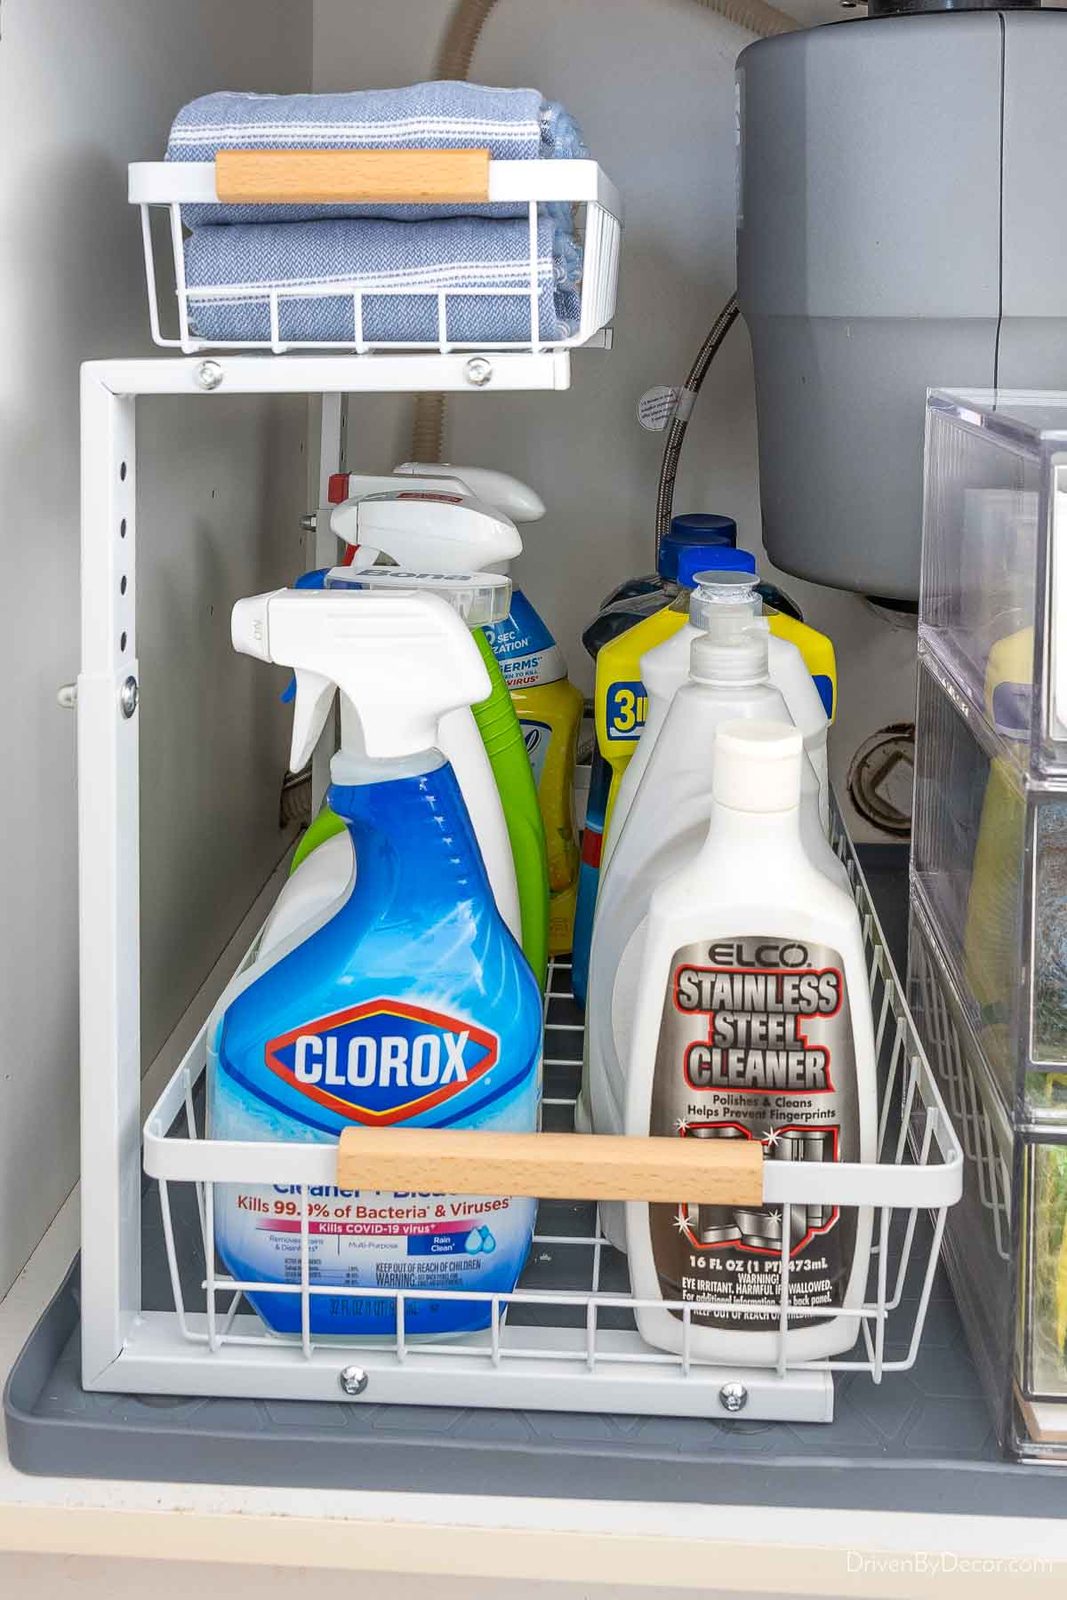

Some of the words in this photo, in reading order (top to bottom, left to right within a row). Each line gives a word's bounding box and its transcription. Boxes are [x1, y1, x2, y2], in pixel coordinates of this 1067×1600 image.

[356, 569, 472, 581] Bona
[497, 631, 516, 642] SEC
[679, 968, 838, 1014] STAINLESS
[713, 1011, 803, 1049] STEEL
[294, 1031, 470, 1087] CLOROX
[689, 1045, 827, 1089] CLEANER
[713, 1095, 759, 1108] Polishes
[761, 1098, 771, 1107] &
[775, 1097, 812, 1108] Cleans
[688, 1105, 719, 1118] Helps
[722, 1107, 766, 1119] Prevent
[770, 1109, 836, 1123] Fingerprints
[237, 1195, 270, 1213] Kills
[334, 1204, 351, 1218] of
[435, 1204, 446, 1217] &
[319, 1222, 342, 1233] Kills
[346, 1223, 400, 1234] COVID-19
[433, 1235, 451, 1244] Rain
[376, 1262, 393, 1273] KEEP
[393, 1262, 407, 1273] OUT
[408, 1262, 417, 1273] OF
[418, 1261, 439, 1273] REACH
[440, 1261, 449, 1272] OF
[449, 1258, 482, 1271] CHILDREN
[689, 1256, 706, 1268] 16
[710, 1258, 722, 1270] FL
[726, 1260, 744, 1272] OZ
[747, 1260, 760, 1273] (1
[788, 1258, 828, 1272] 473mL
[682, 1277, 695, 1290] EYE
[697, 1279, 735, 1295] IRRITANT.
[736, 1283, 773, 1296] HARMFUL
[775, 1284, 782, 1296] IF
[787, 1279, 833, 1295] WALLOWED.
[738, 1273, 780, 1285] WARNING!
[682, 1290, 694, 1302] For
[695, 1293, 731, 1304] additional
[793, 1295, 810, 1306] back
